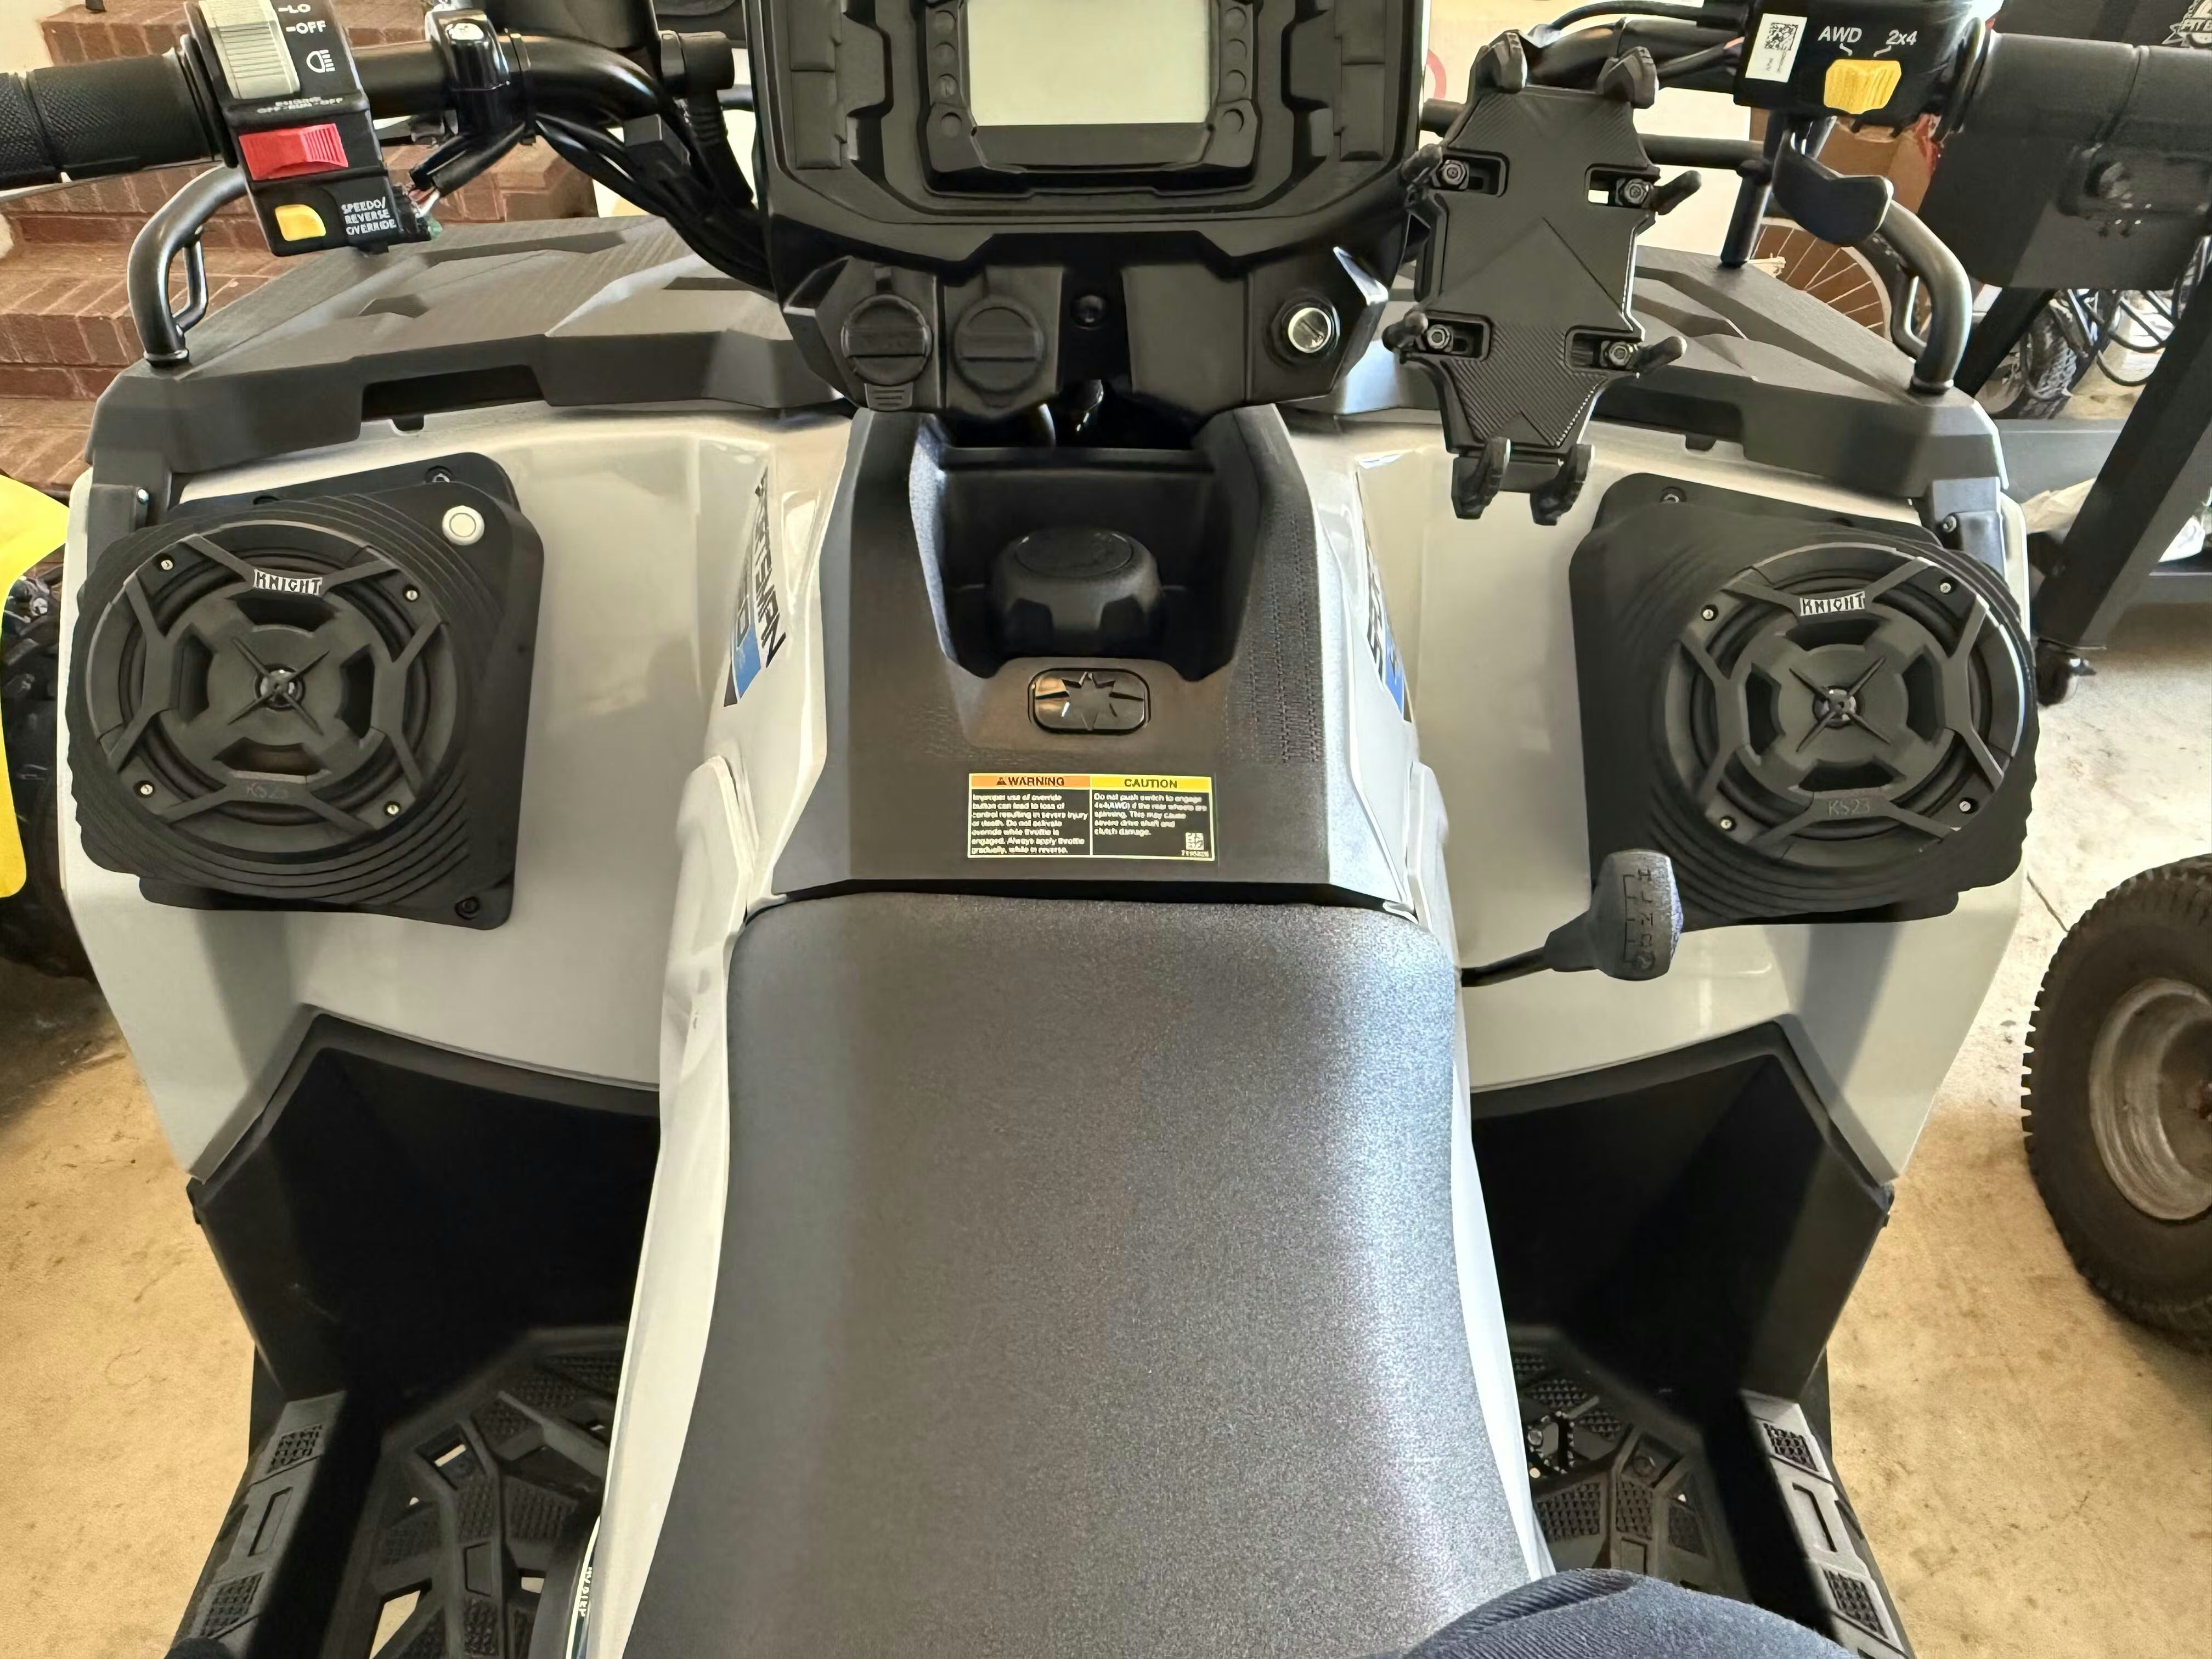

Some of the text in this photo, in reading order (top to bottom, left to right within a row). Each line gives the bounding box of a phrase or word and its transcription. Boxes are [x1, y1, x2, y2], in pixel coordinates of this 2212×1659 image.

[1818, 26, 1863, 43] AWD
[1886, 29, 1917, 46] 2x4
[341, 196, 386, 215] SPEEDO/
[345, 209, 391, 224] REVERSE
[346, 219, 397, 235] OVERRIDE
[256, 571, 321, 595] KNIGHT
[1008, 777, 1065, 786] WARNING
[1124, 778, 1177, 788] CAUTION
